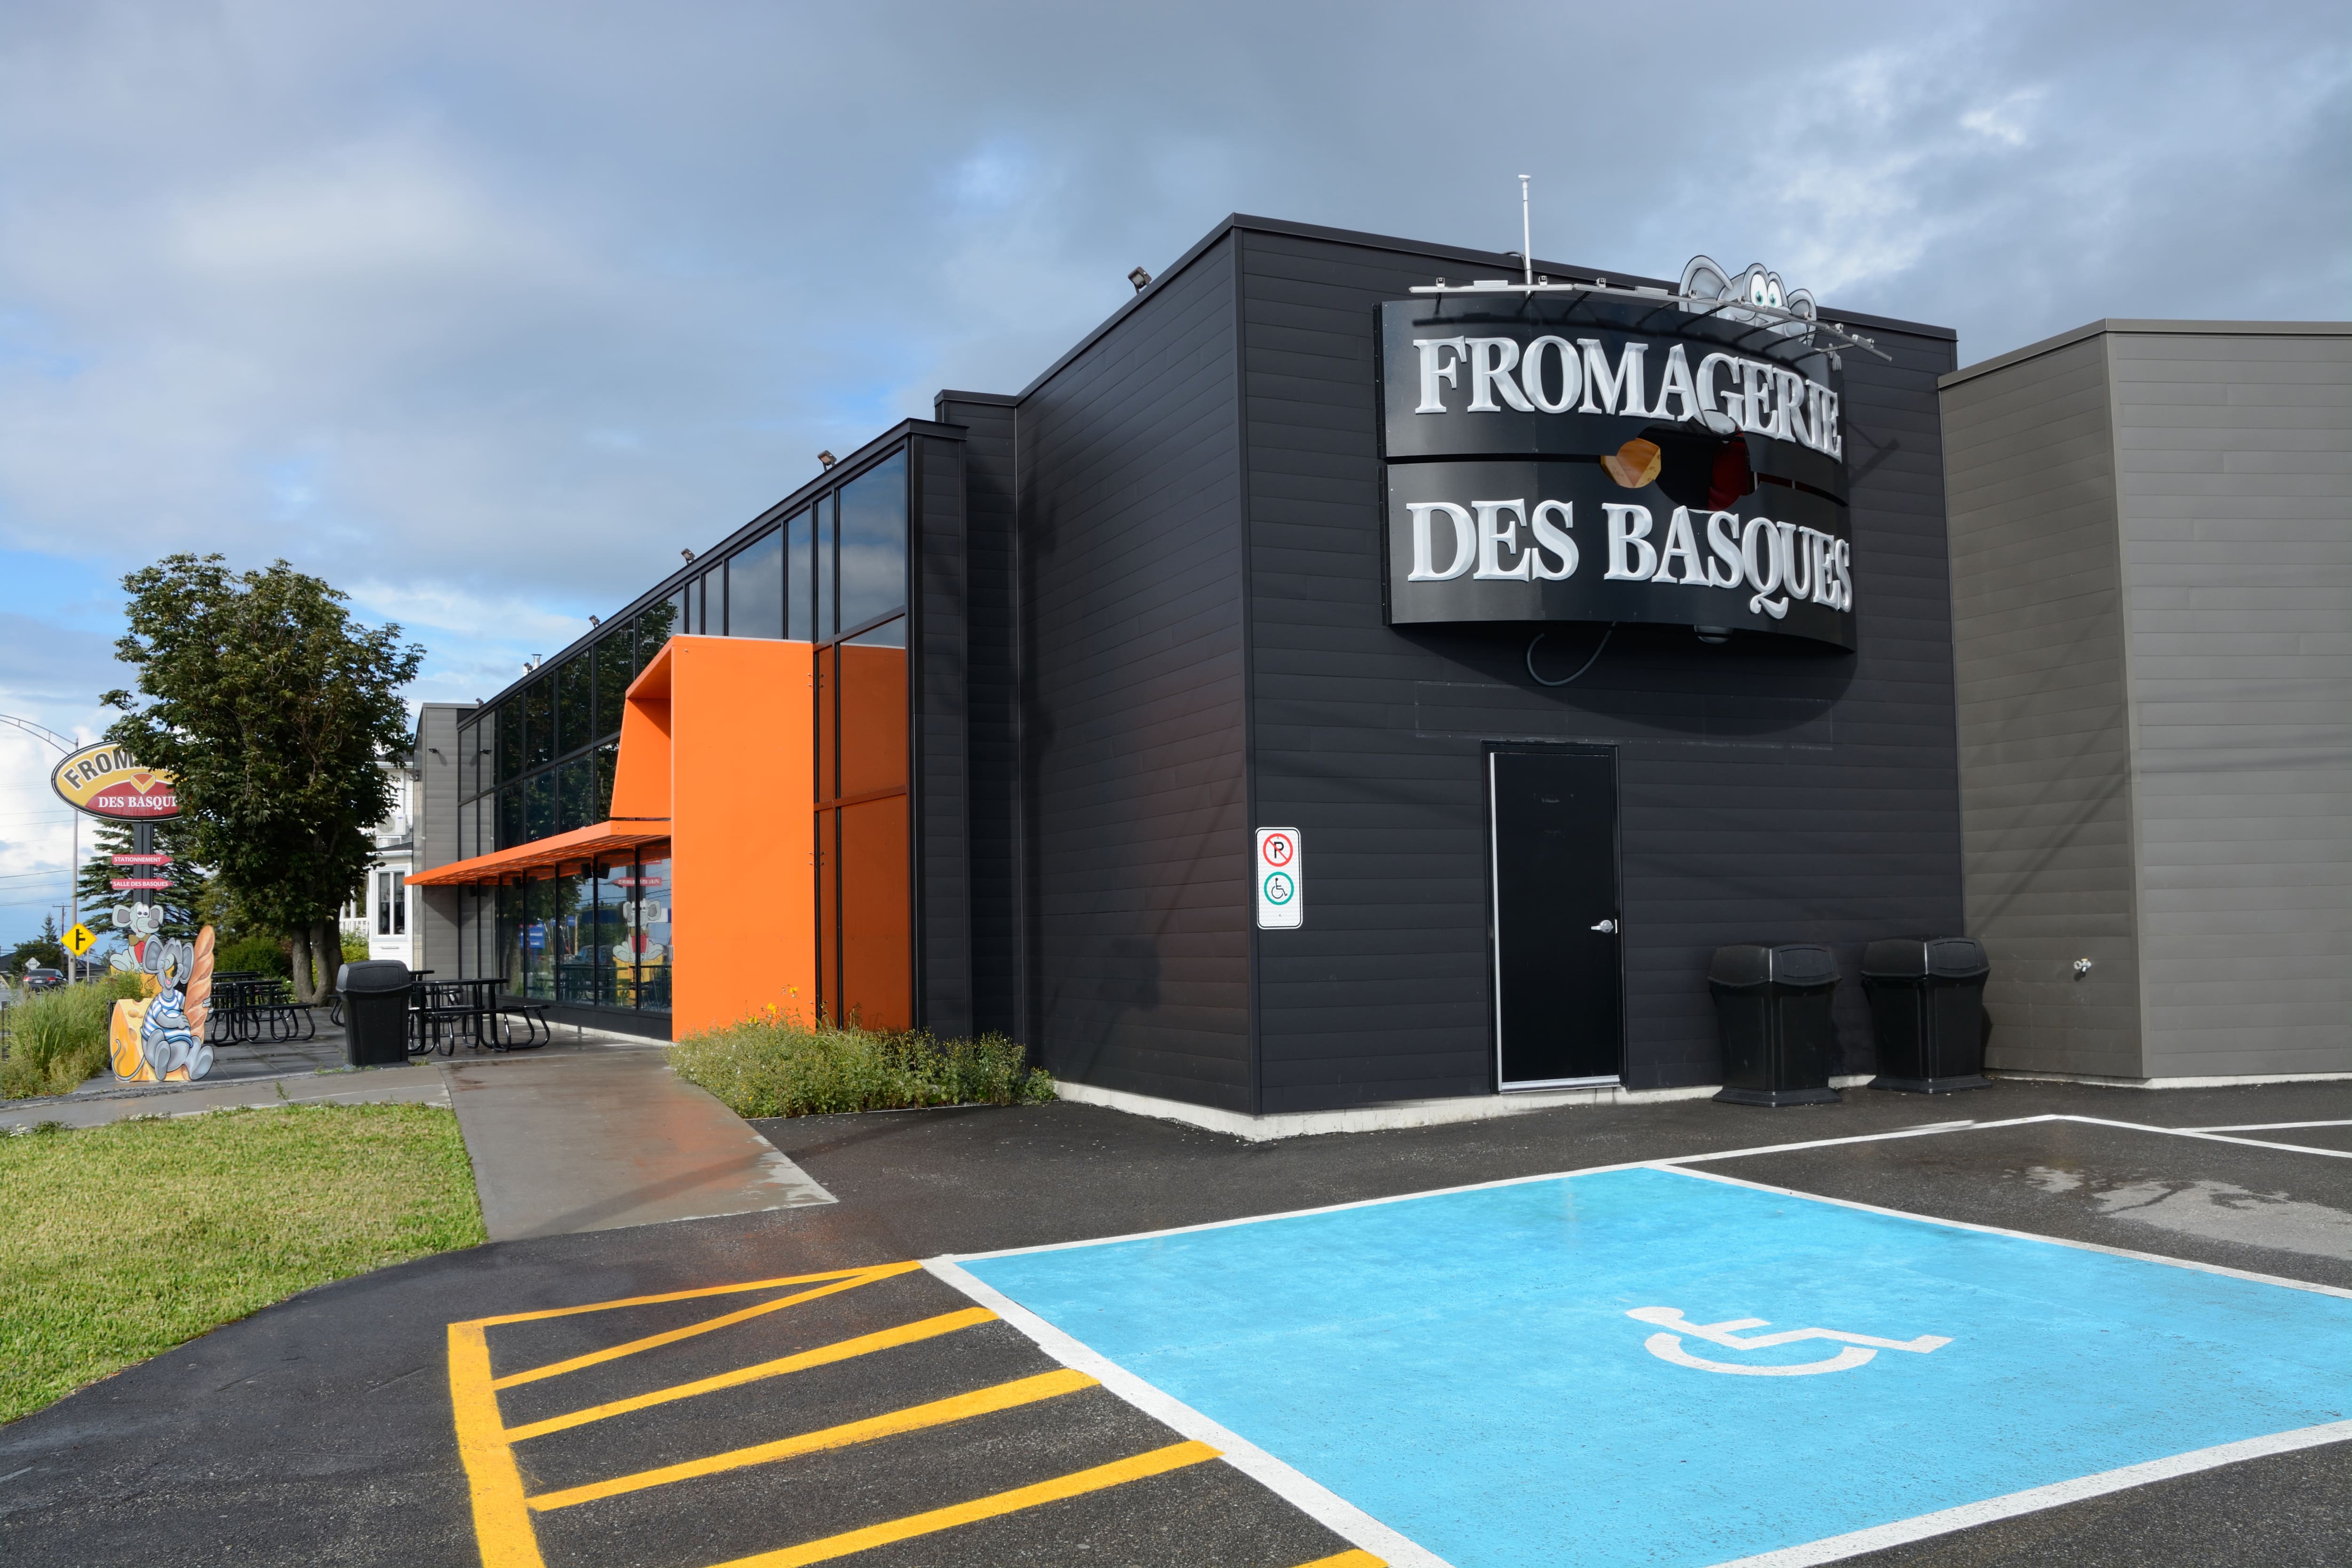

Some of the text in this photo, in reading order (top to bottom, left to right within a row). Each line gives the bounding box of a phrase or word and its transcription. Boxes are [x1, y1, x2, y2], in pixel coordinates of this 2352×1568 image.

[1413, 335, 1842, 463] FROMAGERIE
[1406, 498, 1852, 620] DES BASQUES
[63, 749, 135, 789] FROM
[98, 796, 124, 807] DES
